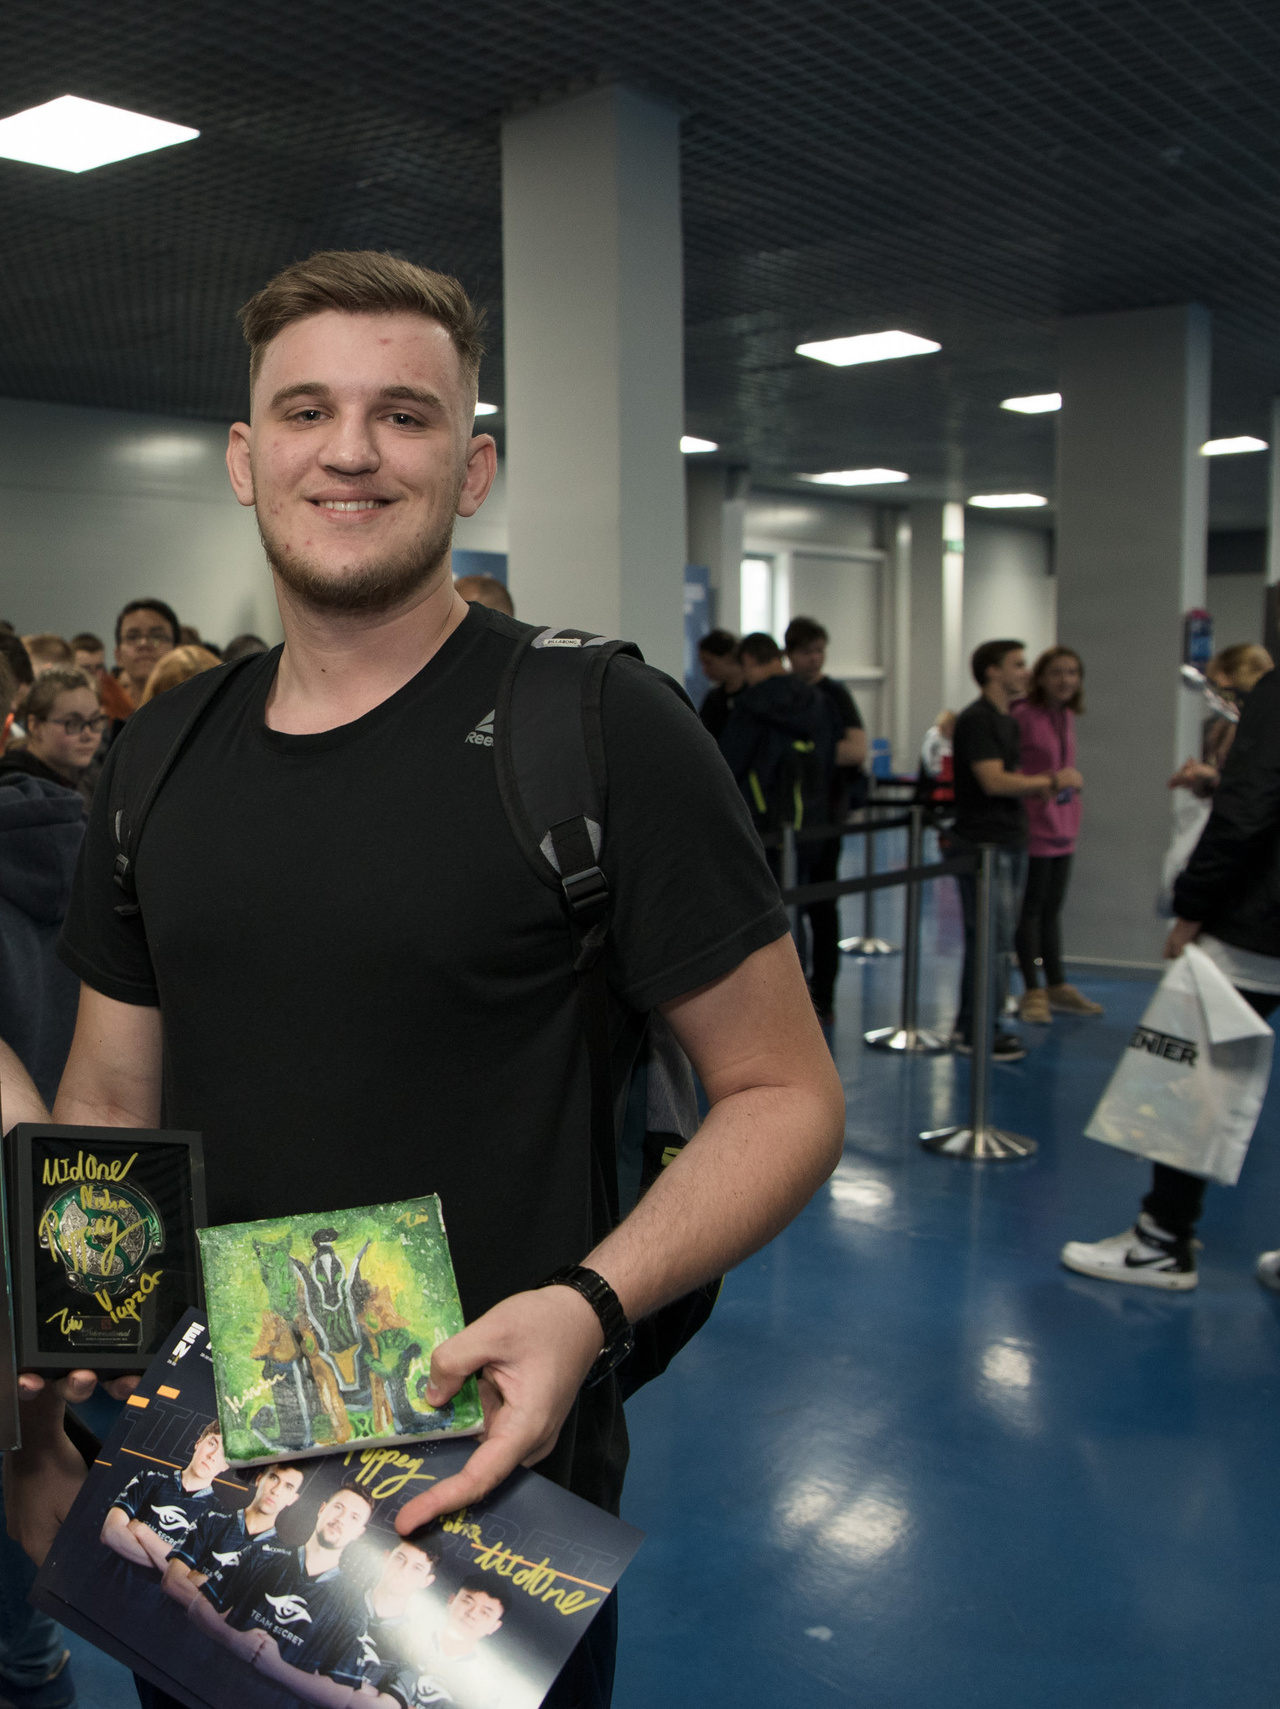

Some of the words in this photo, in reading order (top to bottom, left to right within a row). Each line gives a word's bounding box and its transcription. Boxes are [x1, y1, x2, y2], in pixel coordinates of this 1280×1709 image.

[343, 1448, 437, 1499] uppey
[251, 1609, 273, 1629] TEAM
[272, 1625, 305, 1647] SECRET
